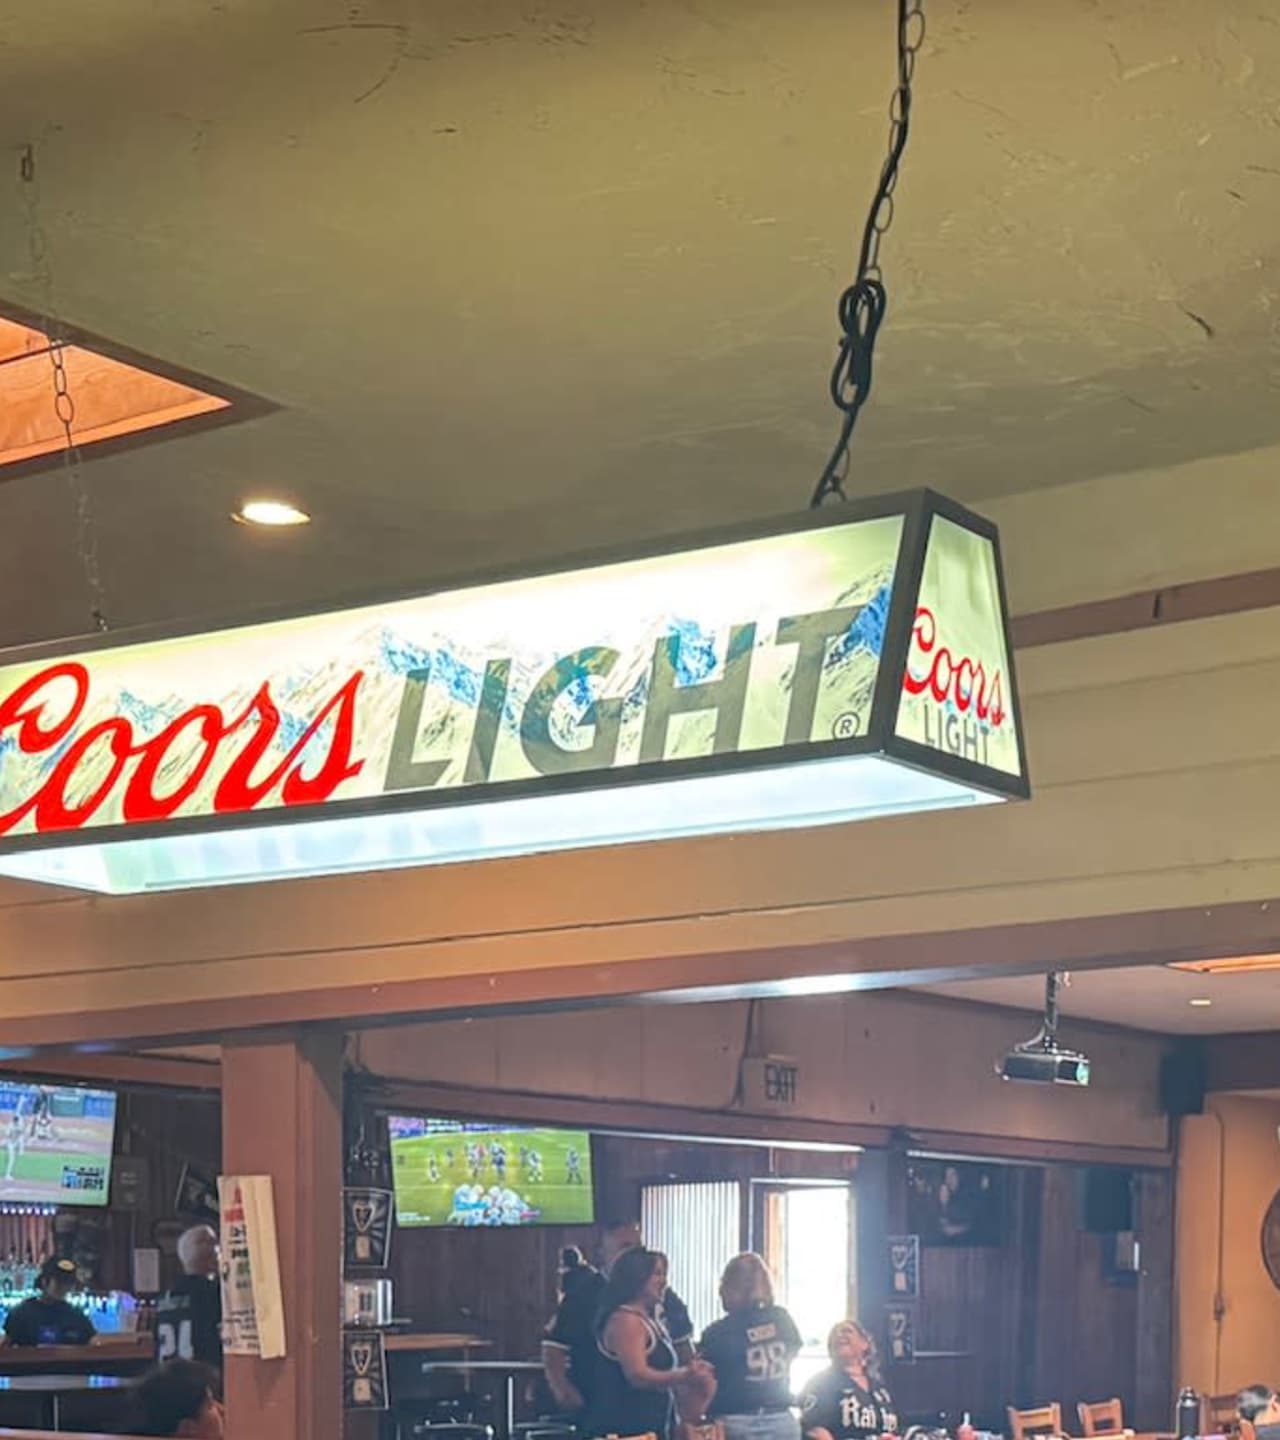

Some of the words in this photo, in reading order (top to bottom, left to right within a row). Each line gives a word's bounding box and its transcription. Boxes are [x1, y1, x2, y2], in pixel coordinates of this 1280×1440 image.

[383, 606, 866, 791] LIGHT
[903, 607, 1005, 727] Coors
[924, 703, 991, 766] LIGHT
[764, 1063, 798, 1103] EXIT
[745, 1341, 787, 1382] 98
